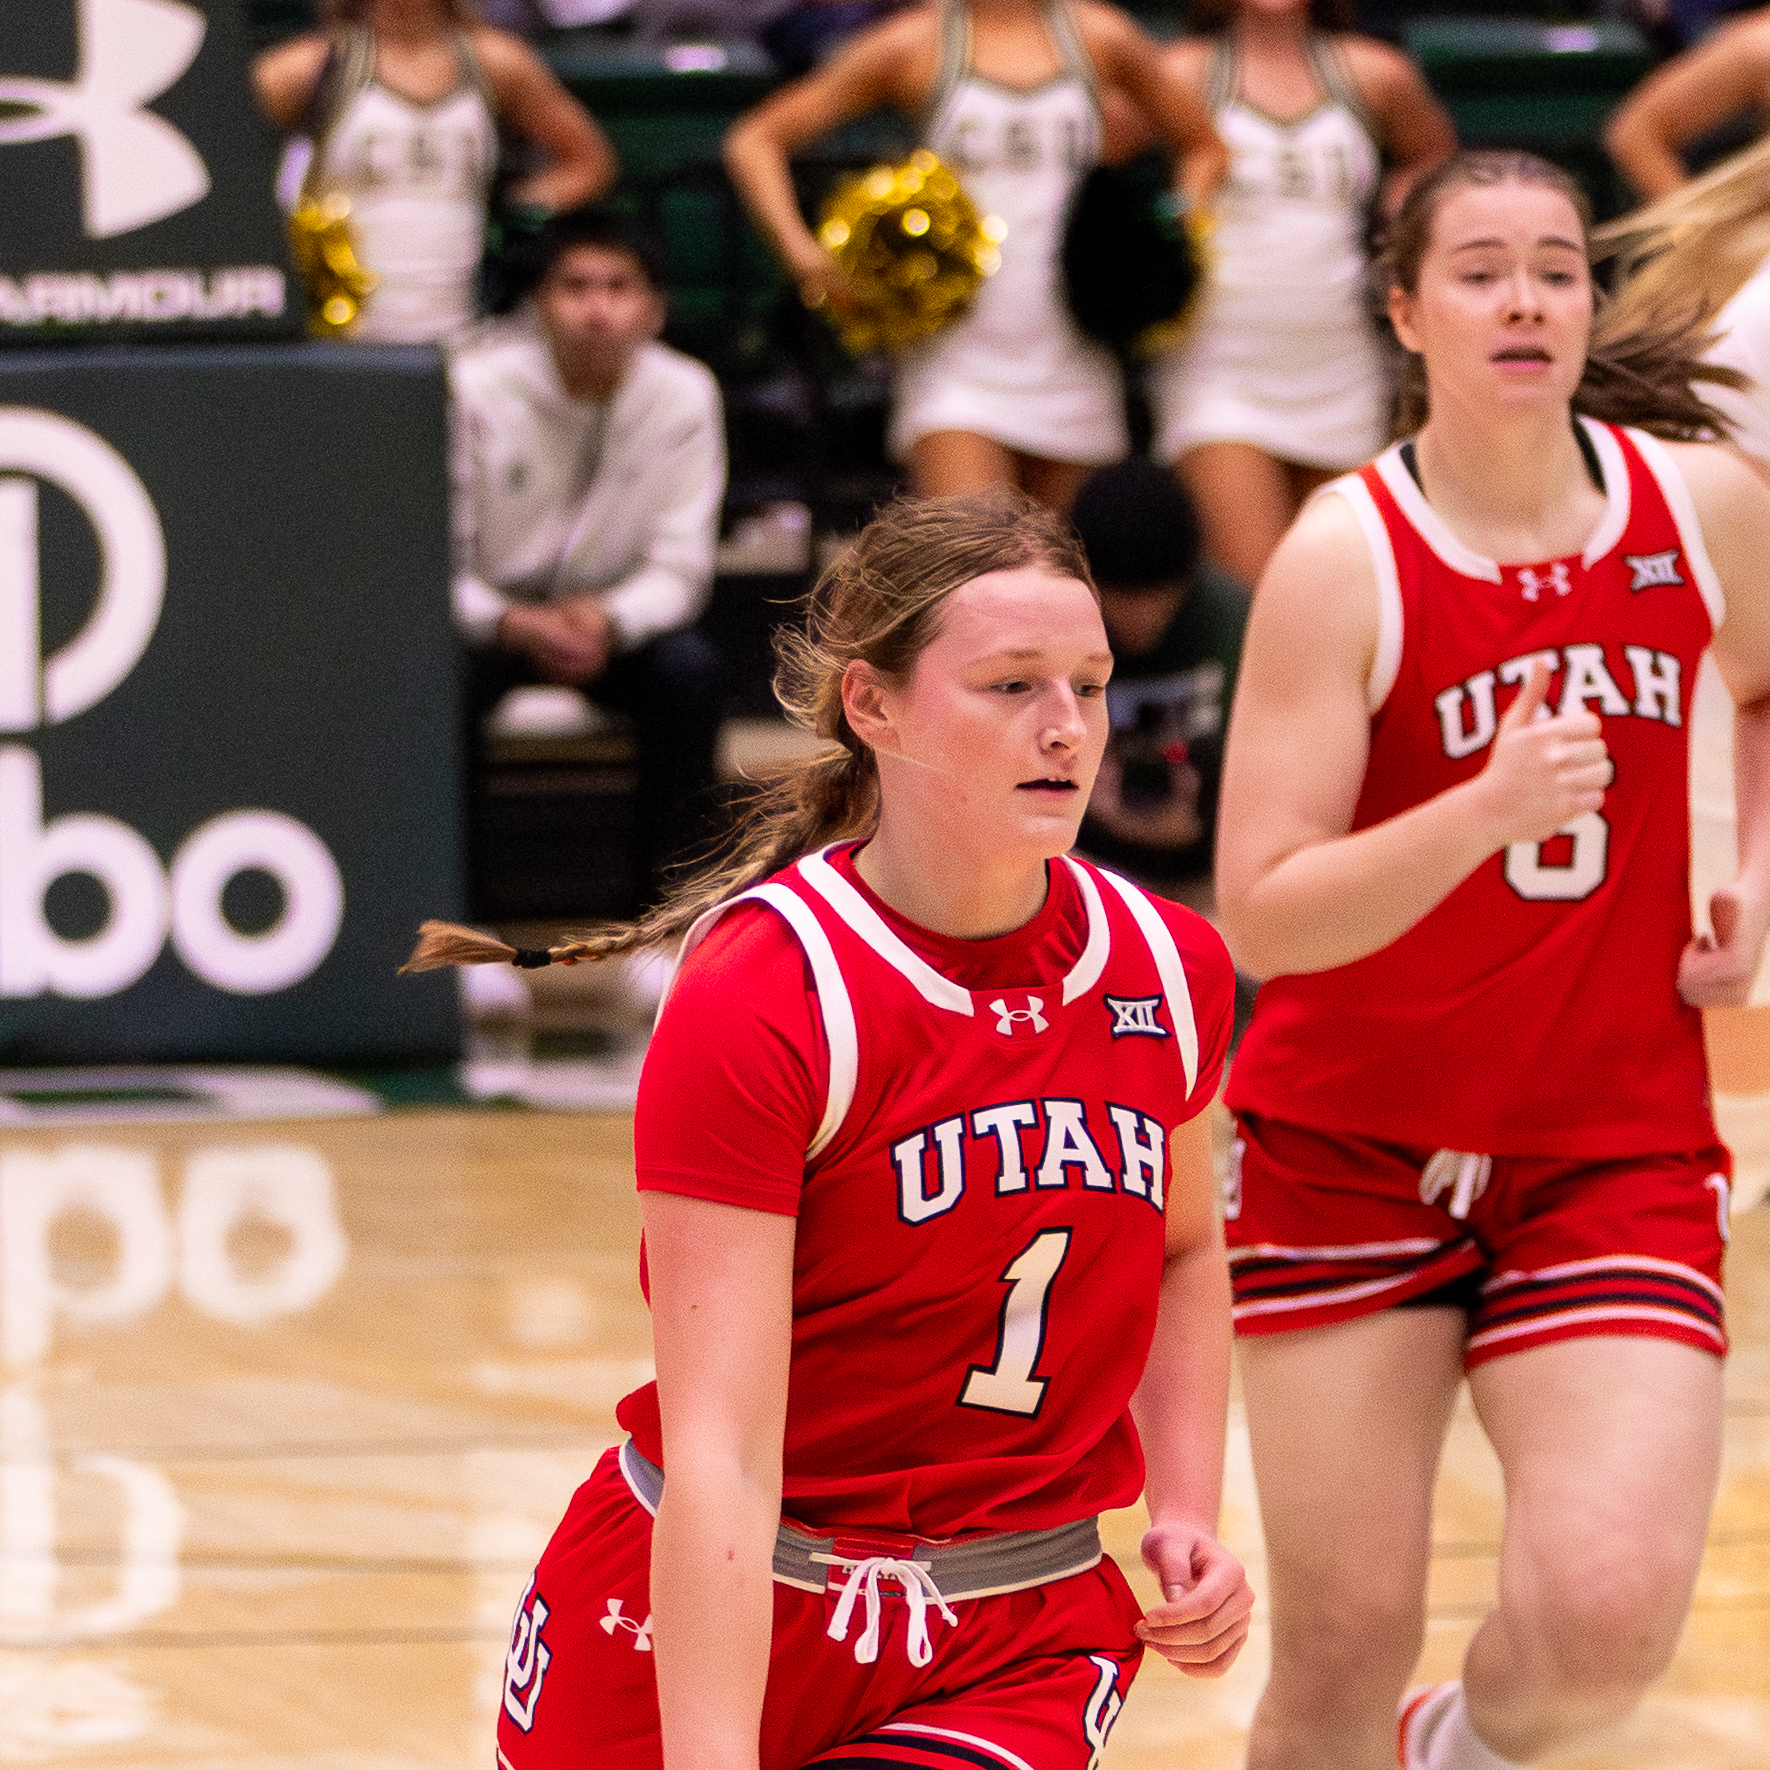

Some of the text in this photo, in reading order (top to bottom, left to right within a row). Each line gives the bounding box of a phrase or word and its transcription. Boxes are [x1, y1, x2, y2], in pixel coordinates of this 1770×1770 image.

[1103, 993, 1172, 1037] XII
[890, 1097, 1166, 1227] UTAH
[955, 1226, 1073, 1419] 1
